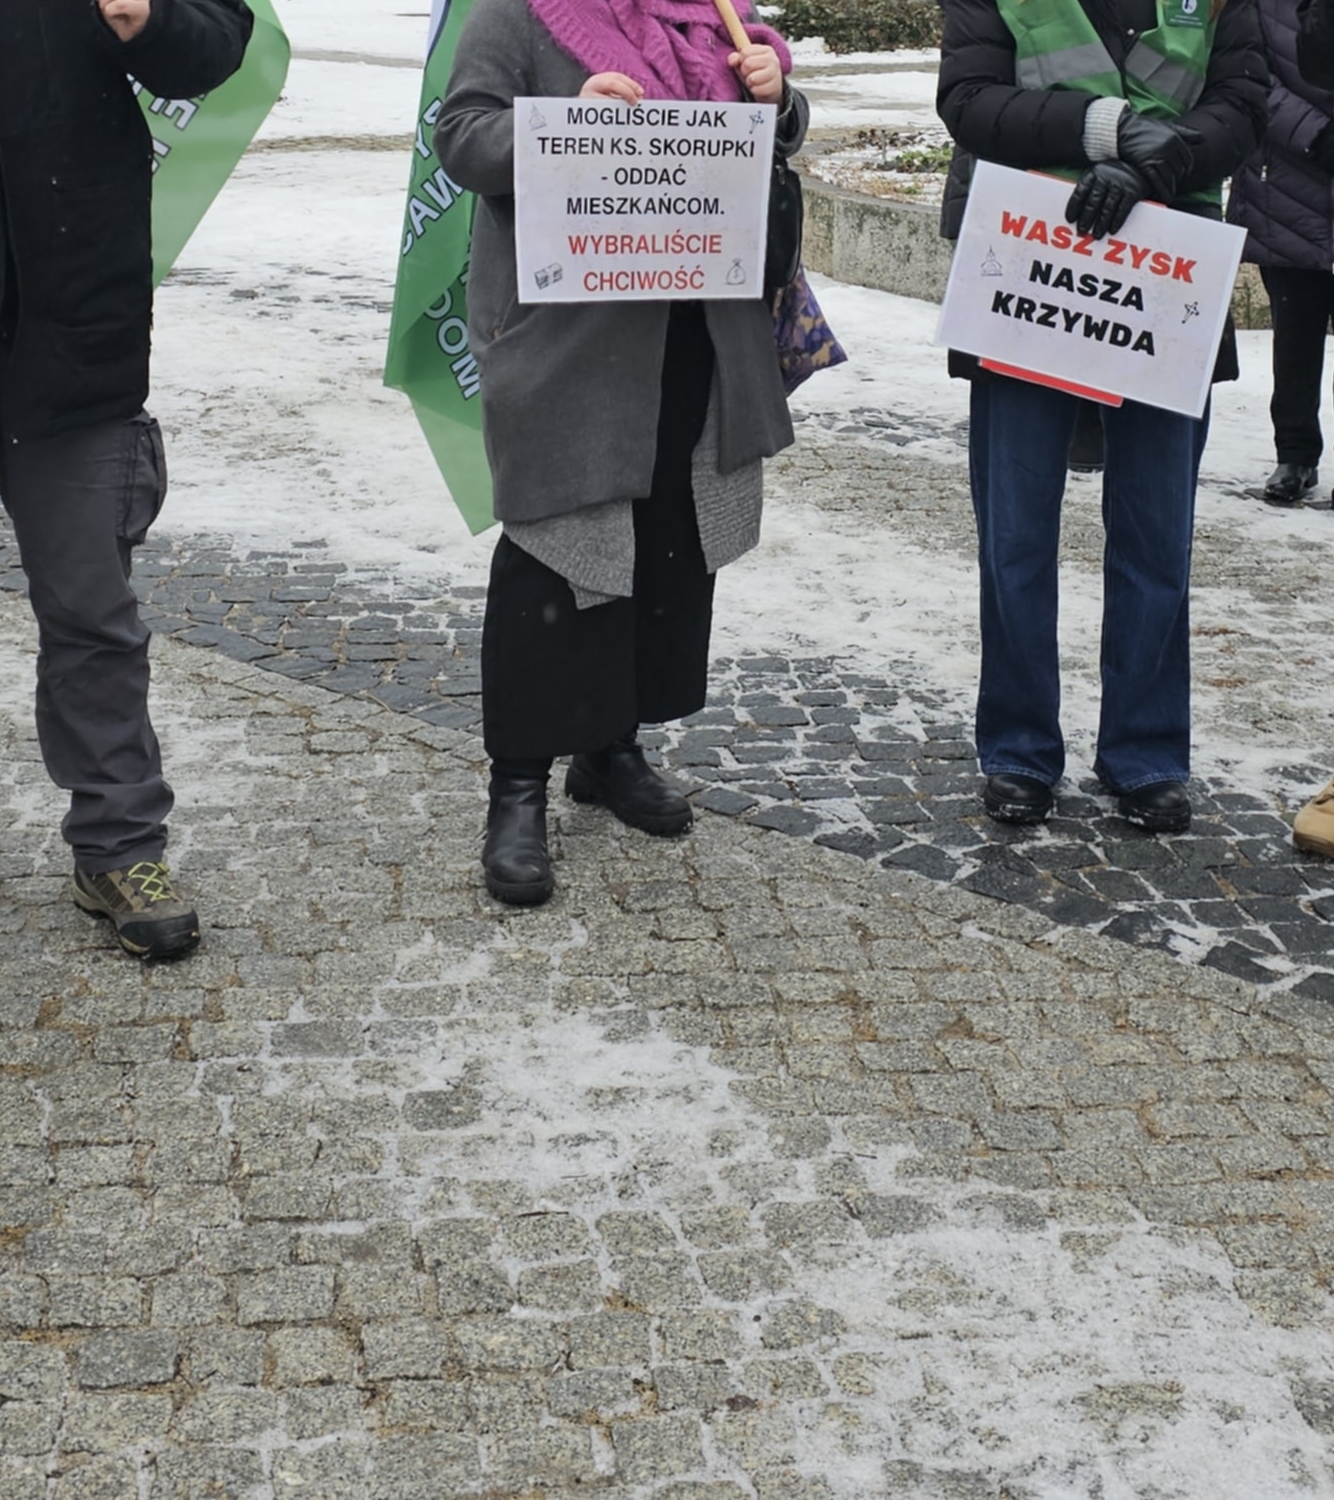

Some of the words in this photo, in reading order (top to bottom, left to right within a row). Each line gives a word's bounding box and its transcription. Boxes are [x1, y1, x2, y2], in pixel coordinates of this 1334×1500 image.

[567, 104, 679, 127] MOGLIŚCIE
[686, 110, 727, 127] JAK
[537, 137, 604, 155] TEREN
[611, 137, 643, 156] KS.
[649, 138, 754, 157] SKORUPKI
[614, 163, 687, 185] ODDAĆ
[567, 193, 725, 215] MIESZKAŃCOM.
[568, 229, 722, 255] WYBRALIŚCIE
[1001, 211, 1096, 257] WASZ
[1103, 238, 1197, 284] ZYSK
[583, 265, 705, 291] CHCIWOŚĆ
[1029, 260, 1144, 312] NASZA
[991, 290, 1156, 357] KRZYWDA
